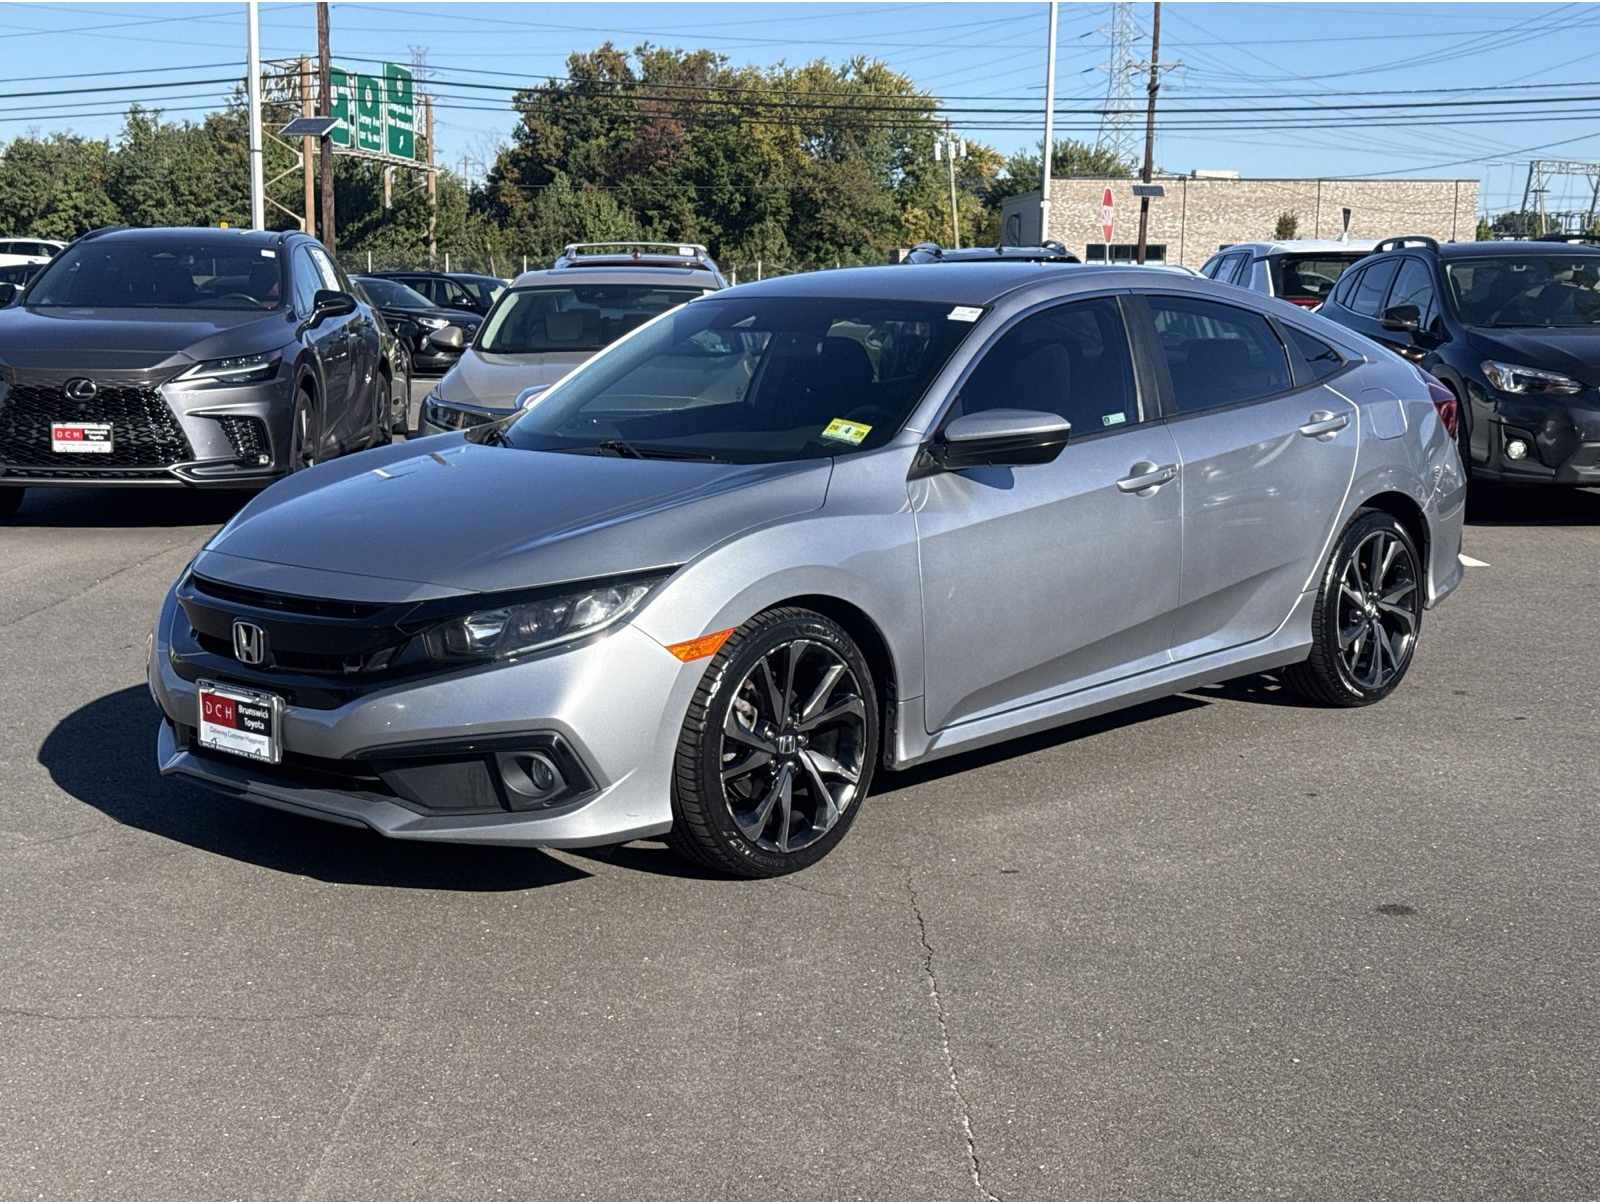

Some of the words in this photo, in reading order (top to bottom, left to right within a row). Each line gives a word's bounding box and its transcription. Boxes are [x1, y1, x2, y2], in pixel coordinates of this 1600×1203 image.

[205, 700, 233, 720] DCH
[238, 704, 269, 719] Brunswick
[244, 717, 264, 730] Toyota
